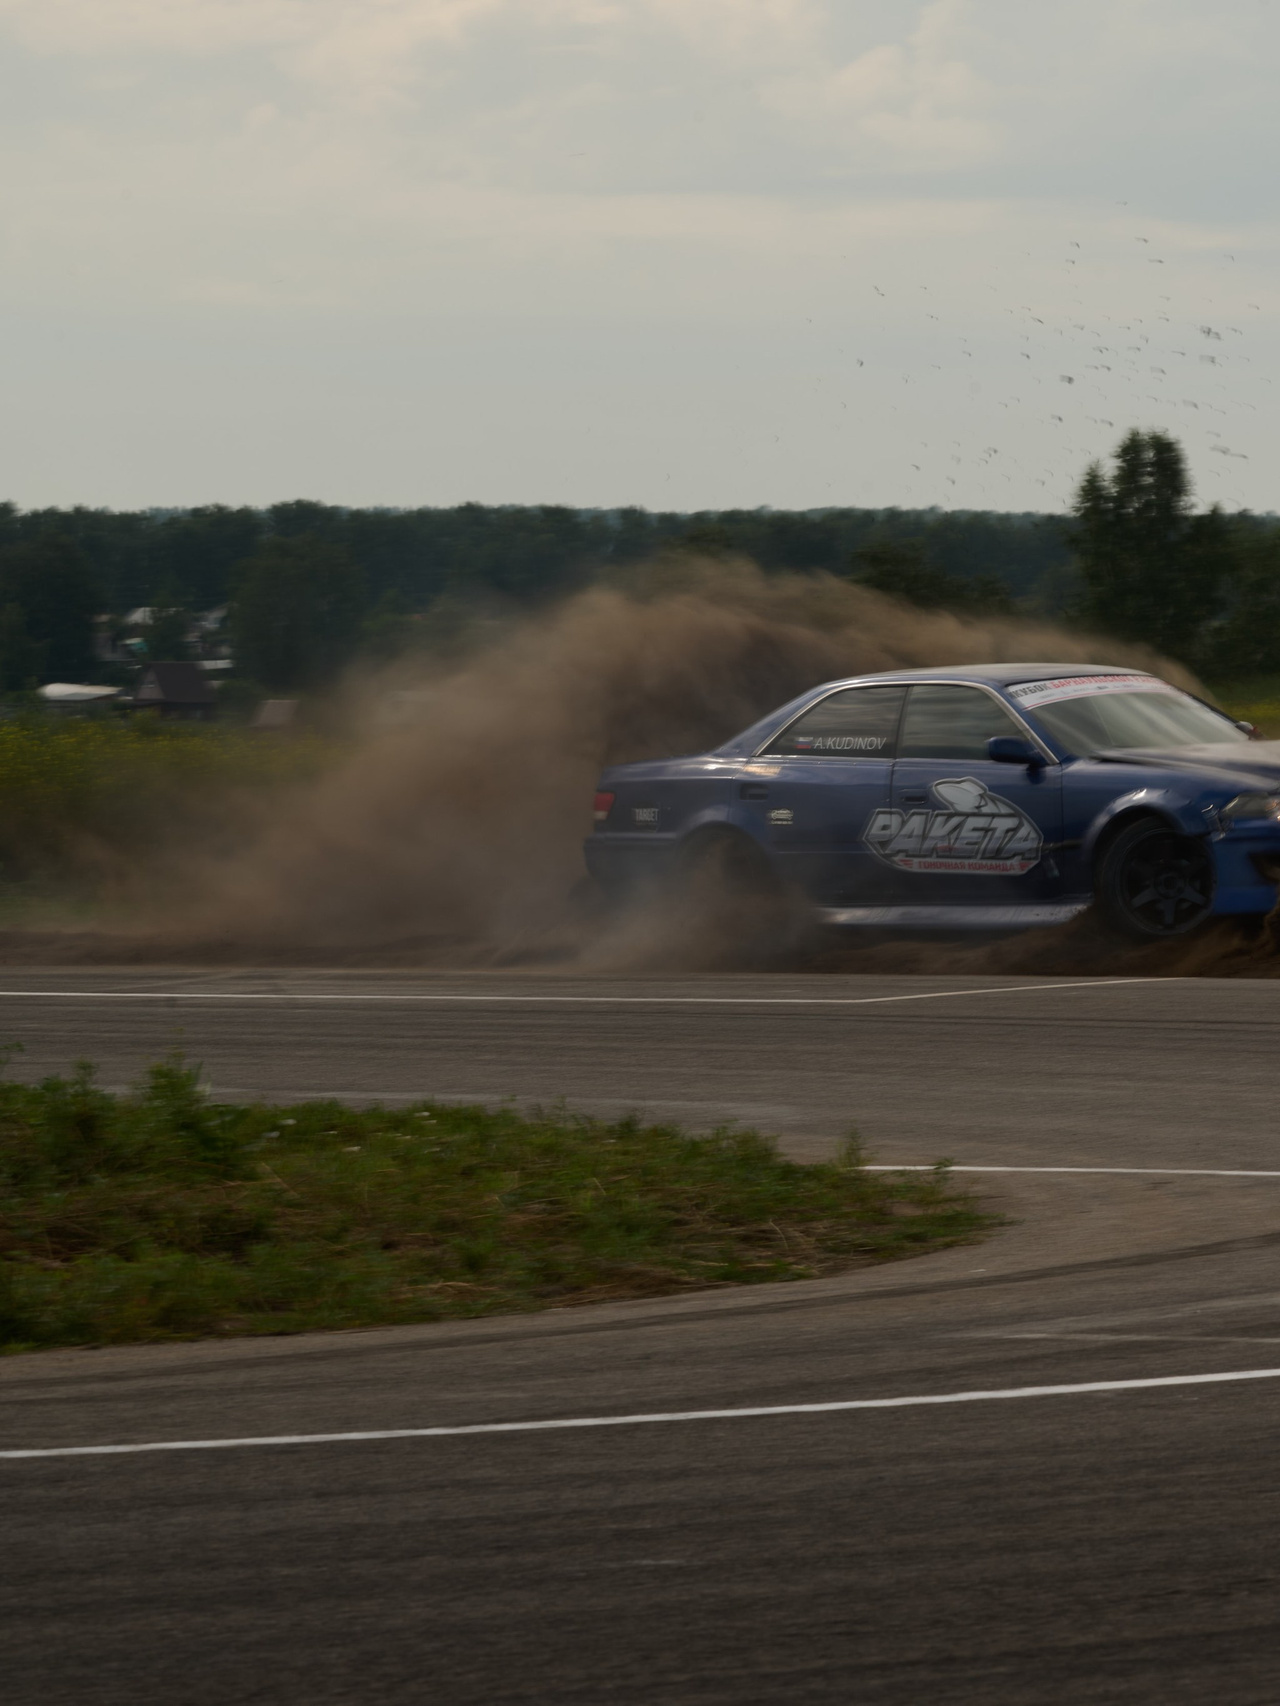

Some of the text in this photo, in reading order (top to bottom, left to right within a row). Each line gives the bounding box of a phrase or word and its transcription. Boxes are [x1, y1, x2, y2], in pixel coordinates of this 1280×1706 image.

[813, 736, 887, 750] A.KUDINOV
[867, 811, 1041, 860] РАКЕТА
[918, 861, 1014, 872] ГОНОЧНАЯ КОМАНДА
